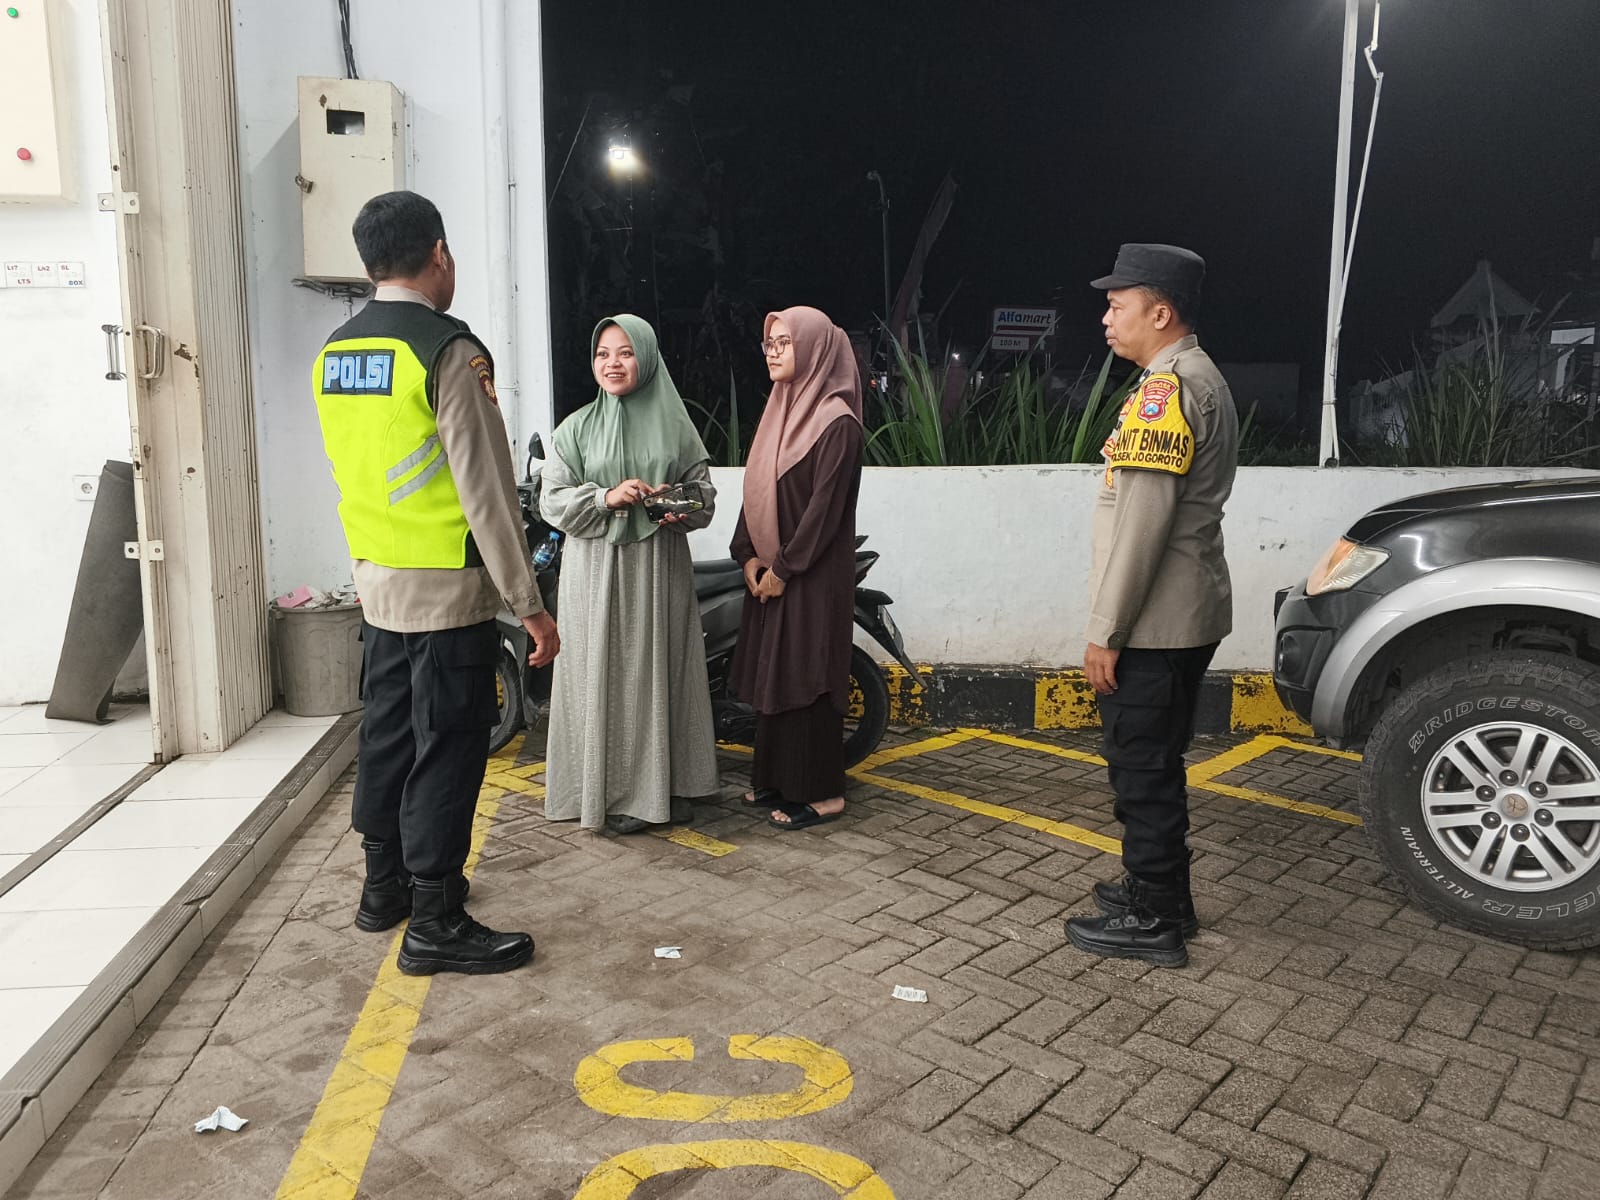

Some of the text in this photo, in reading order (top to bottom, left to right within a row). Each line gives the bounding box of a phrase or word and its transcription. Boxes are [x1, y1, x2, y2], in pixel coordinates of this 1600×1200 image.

[998, 311, 1052, 324] Alfamart
[1139, 428, 1189, 458] BINMAS
[1482, 884, 1600, 920] ELER
